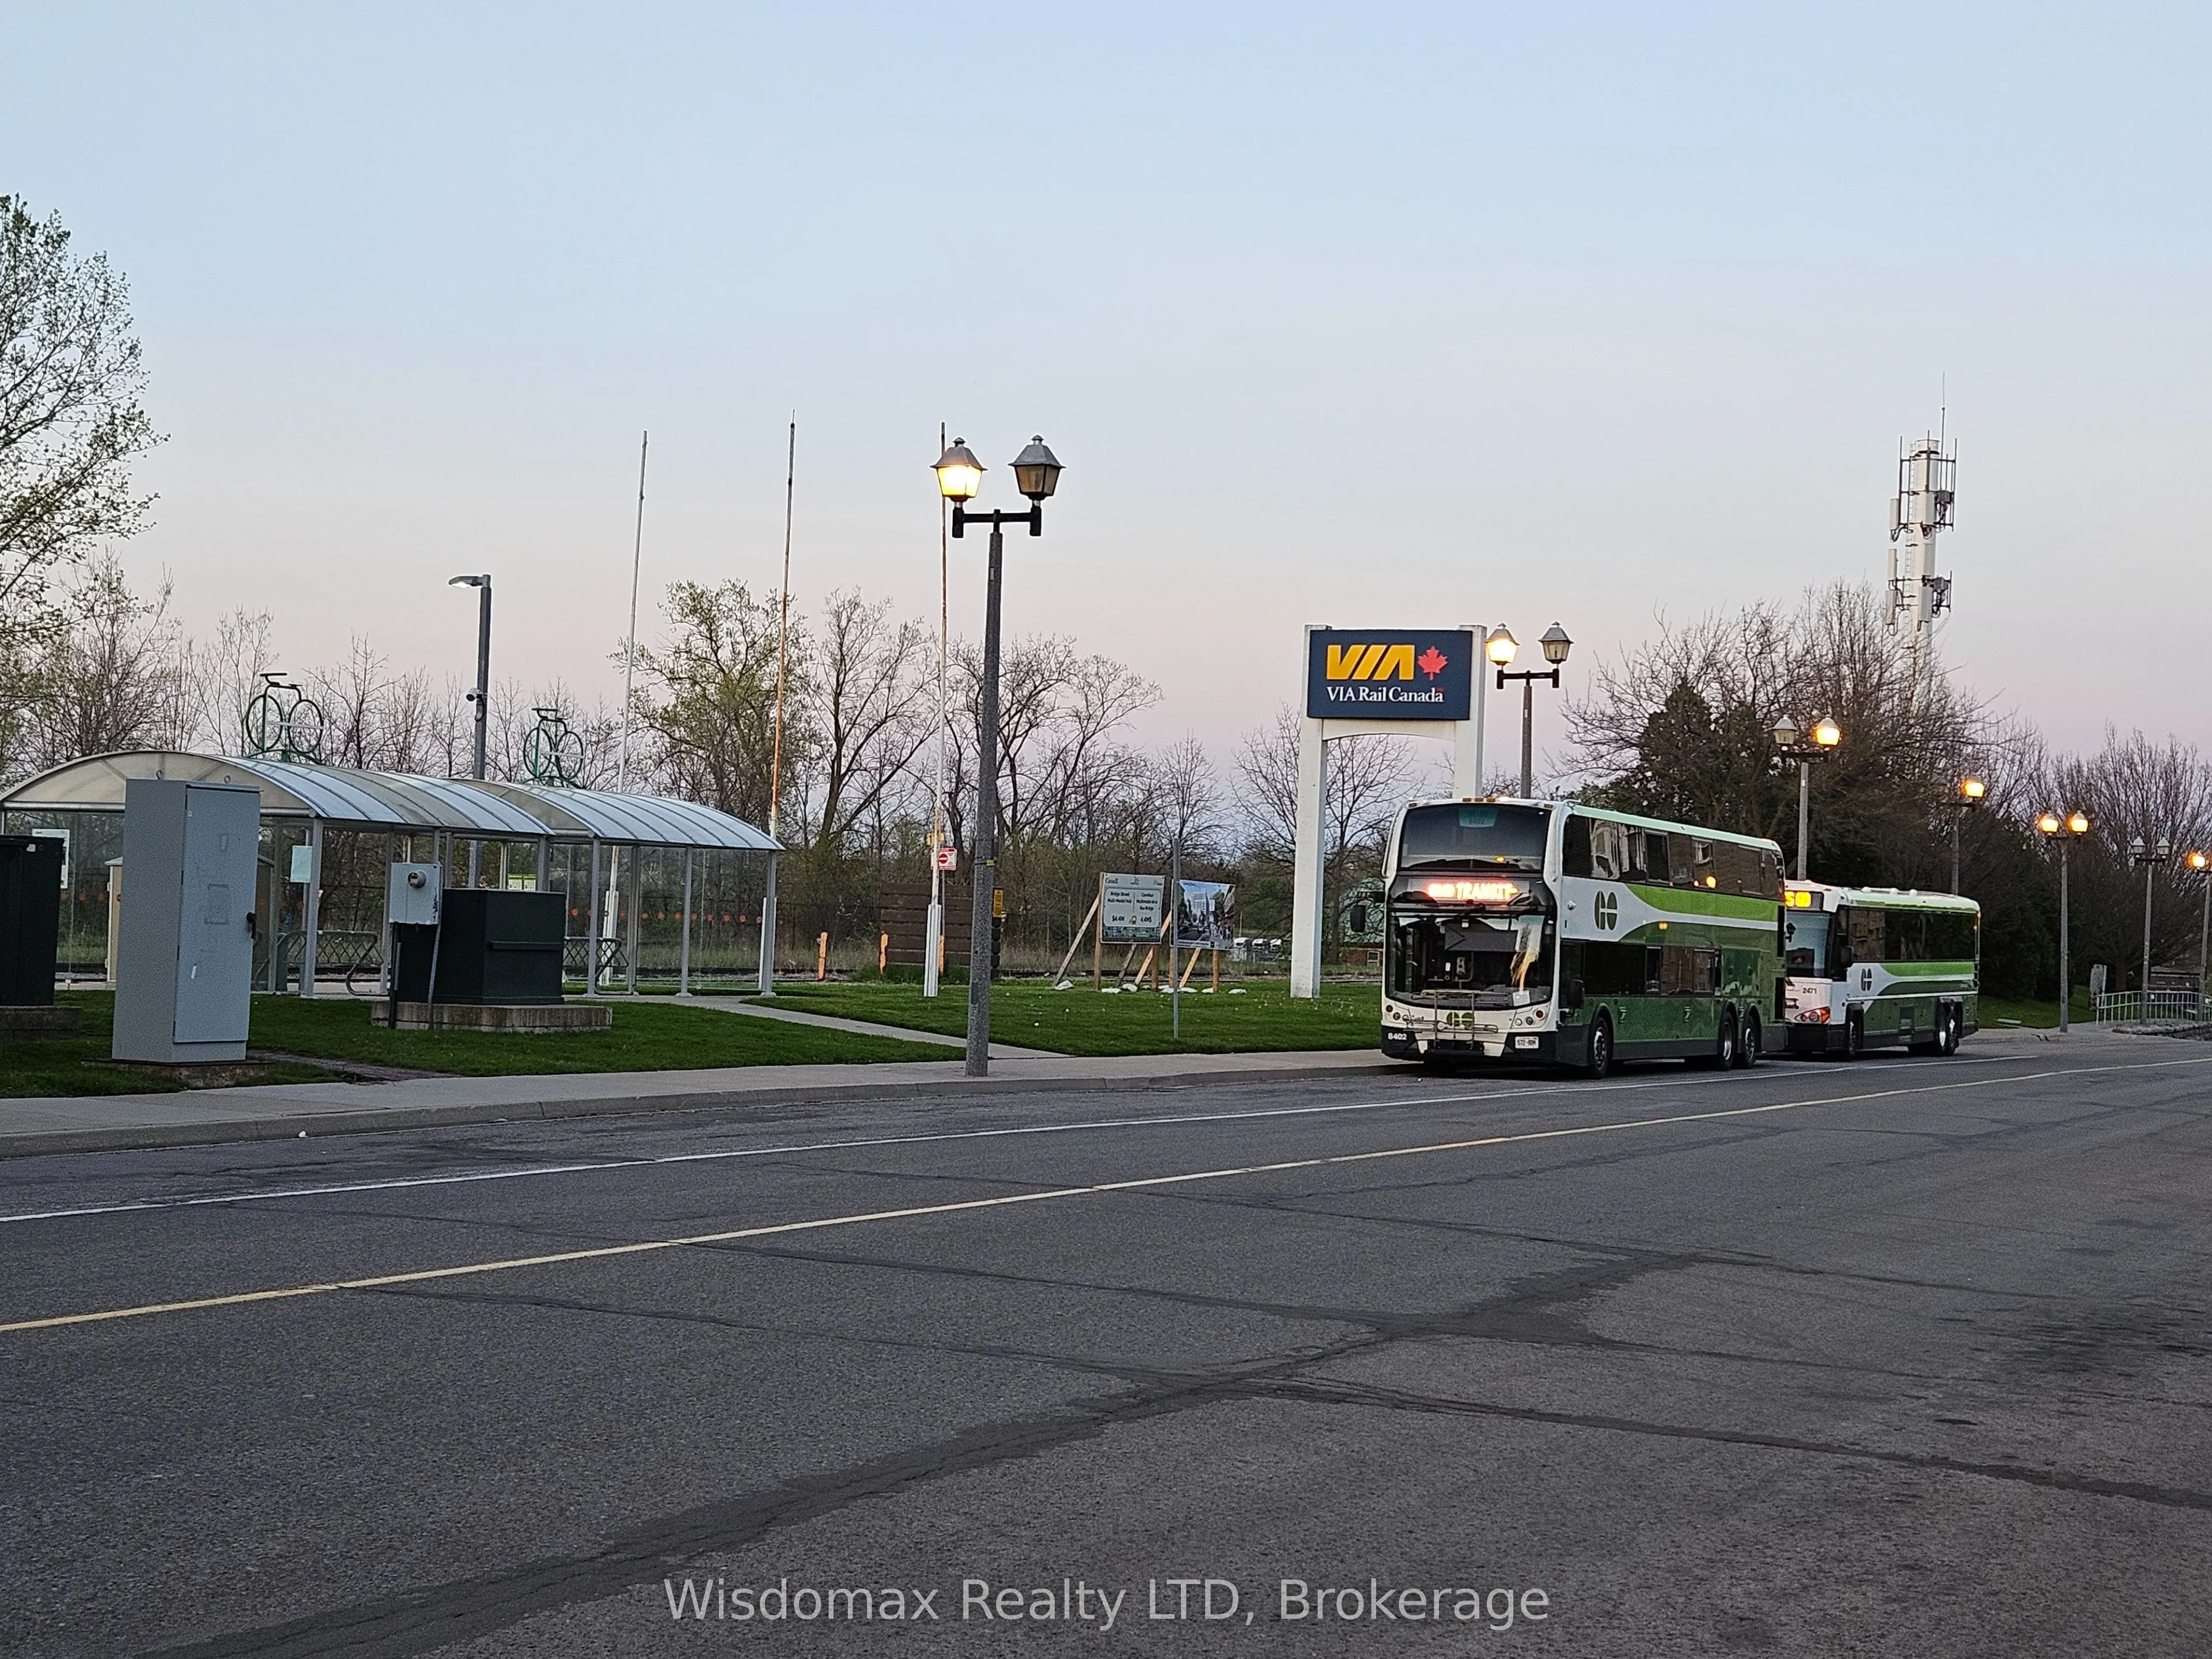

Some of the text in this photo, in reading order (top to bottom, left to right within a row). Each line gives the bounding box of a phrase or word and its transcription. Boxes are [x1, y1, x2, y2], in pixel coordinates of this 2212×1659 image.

[1327, 645, 1415, 680] VIA
[1327, 687, 1445, 703] VIA Rail Canada
